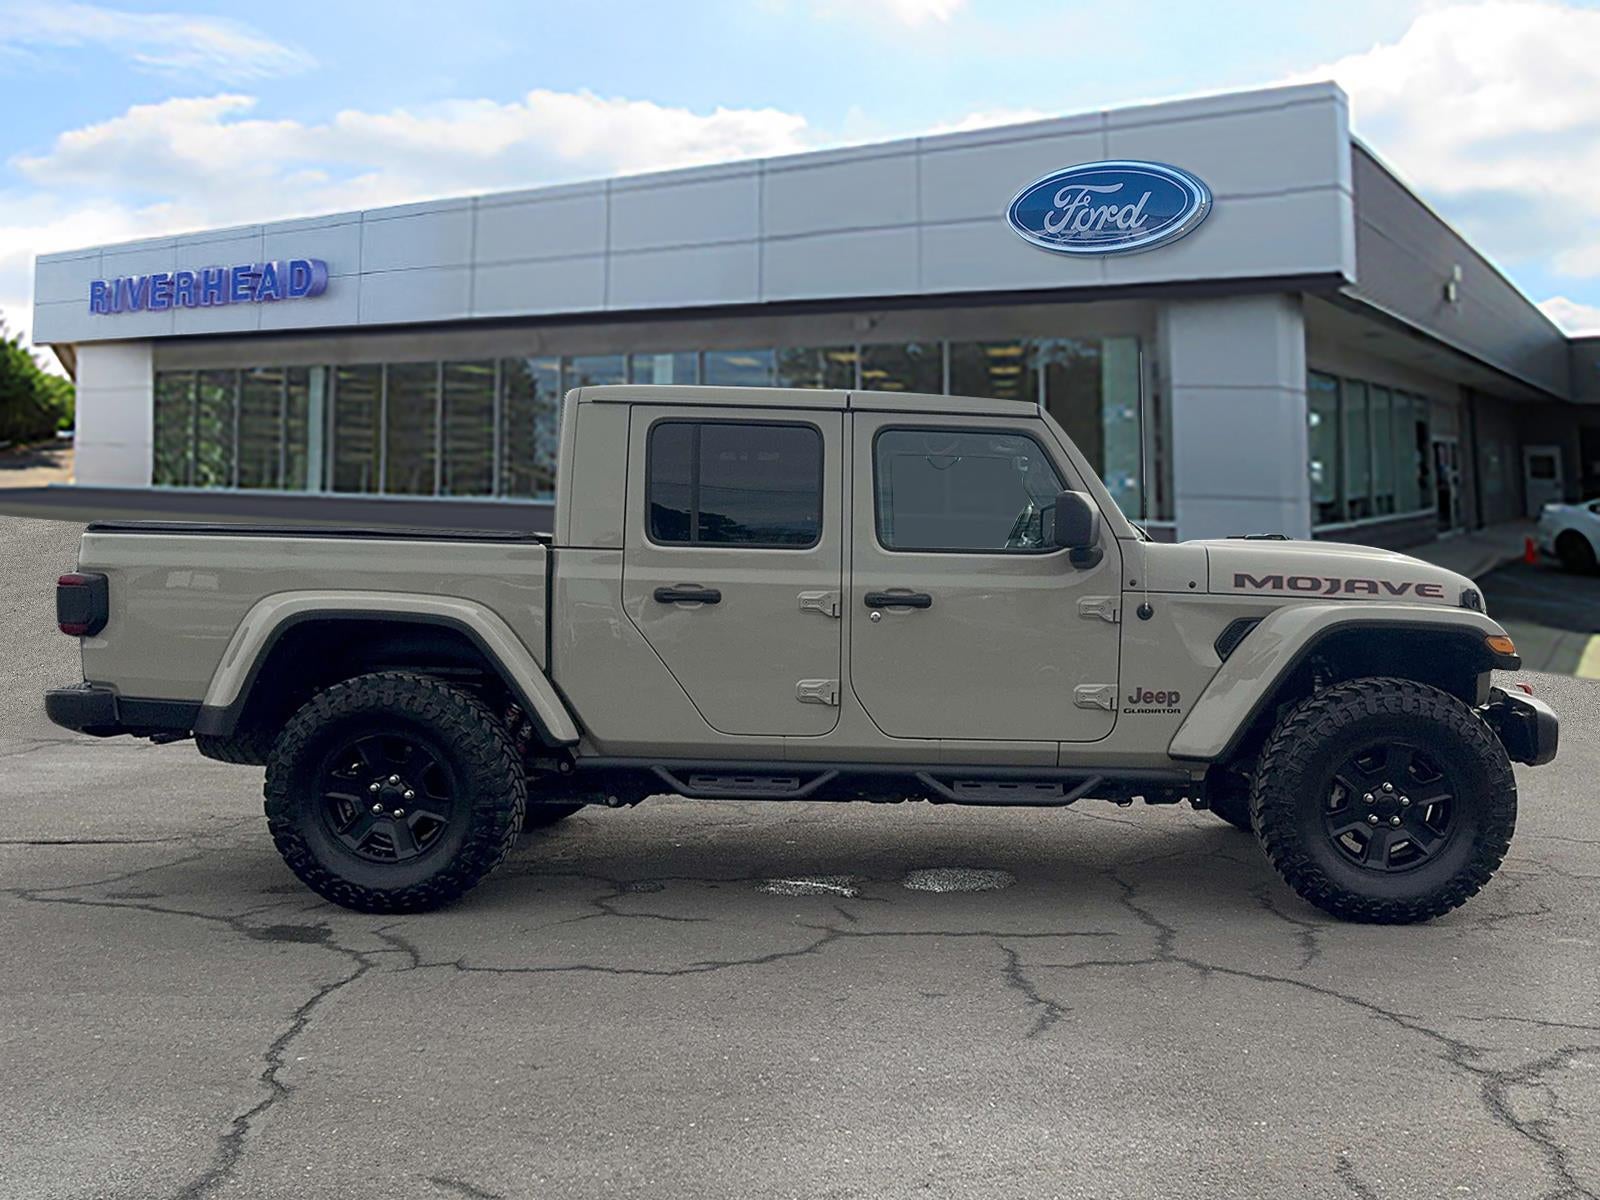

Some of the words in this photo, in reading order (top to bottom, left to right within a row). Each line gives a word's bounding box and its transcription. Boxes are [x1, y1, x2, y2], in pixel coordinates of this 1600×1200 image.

[1043, 182, 1152, 234] Ford
[89, 259, 328, 316] RIVERHEAD
[1233, 573, 1445, 599] MOJAVE
[1127, 687, 1181, 708] Jeep
